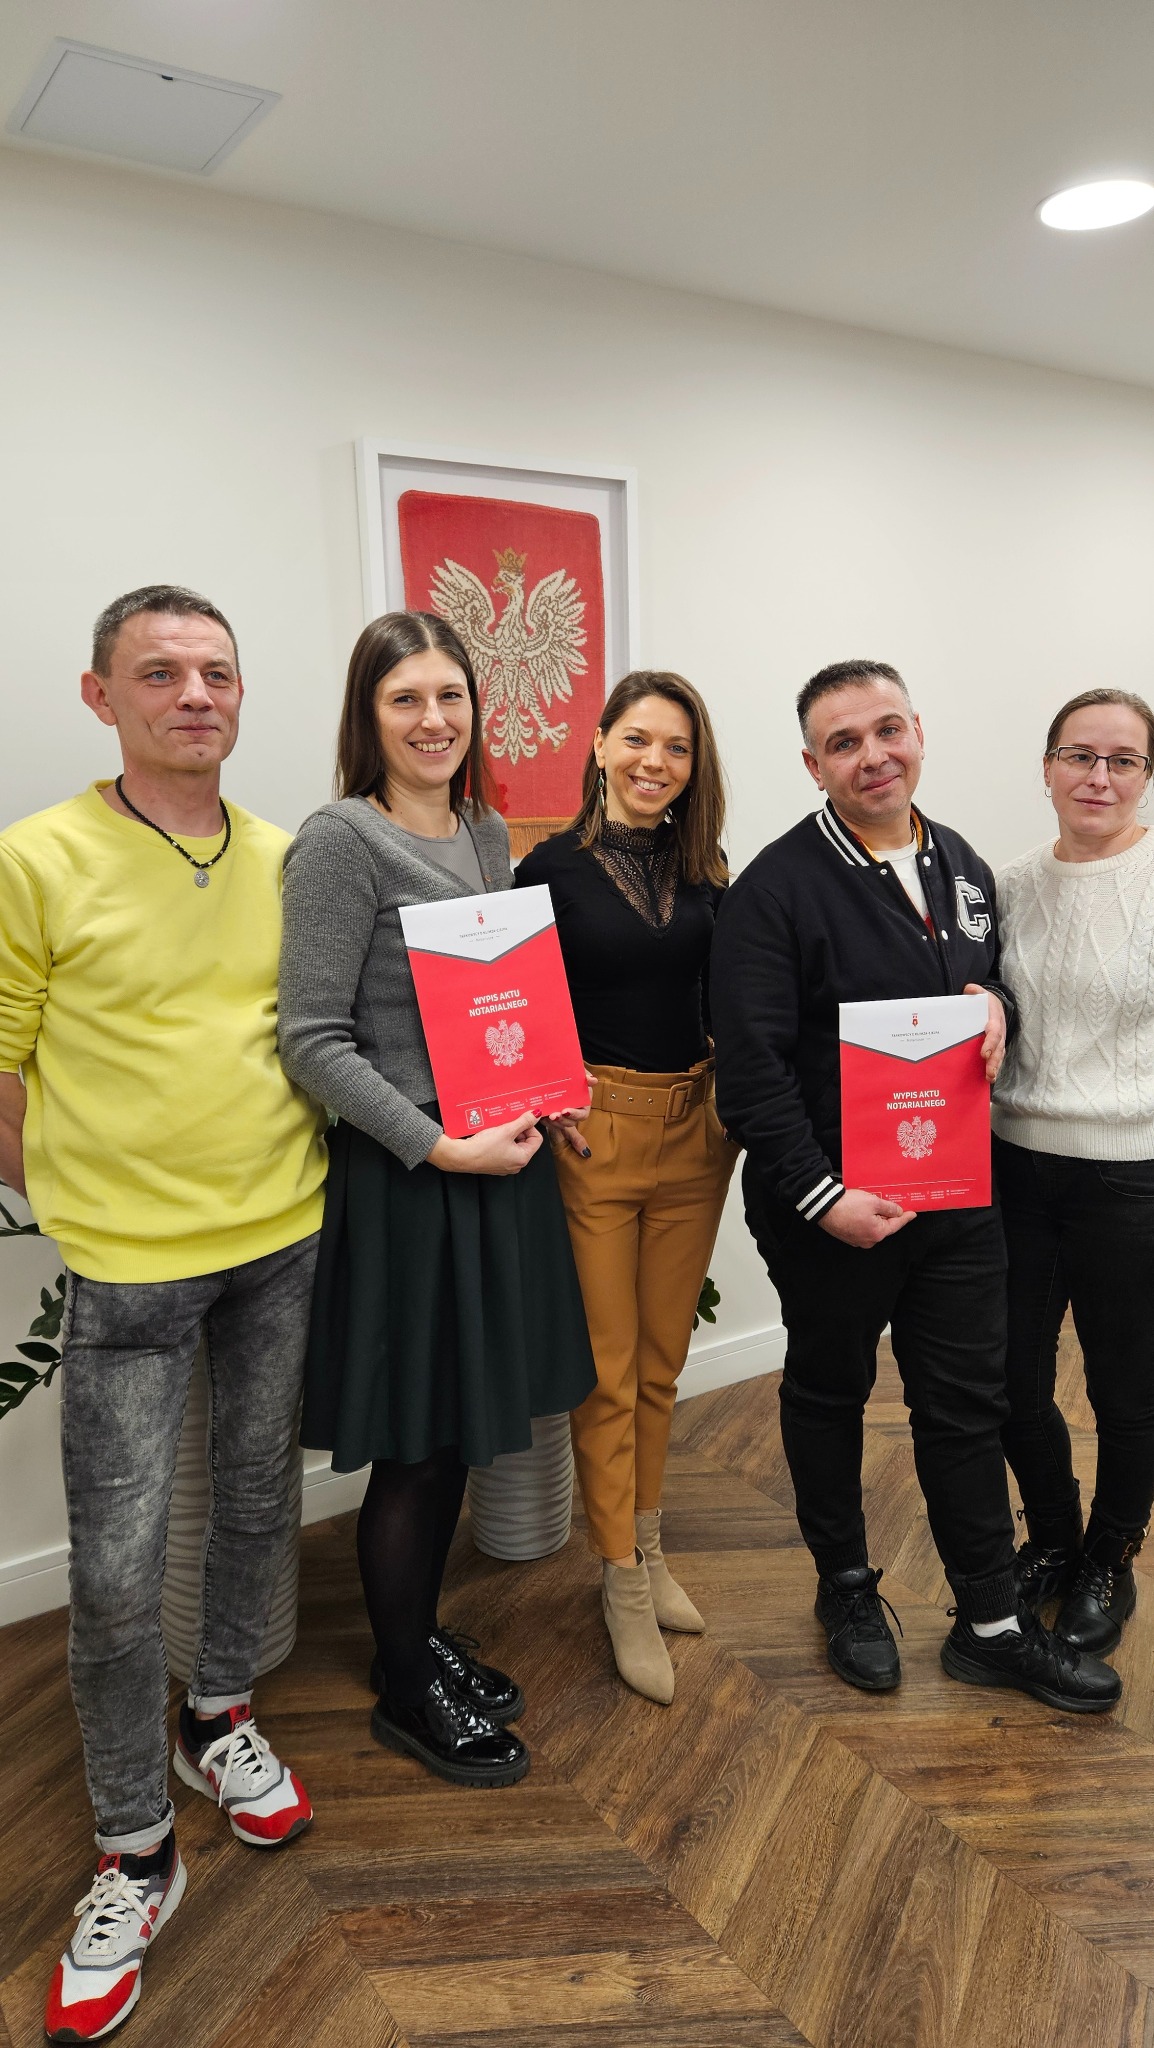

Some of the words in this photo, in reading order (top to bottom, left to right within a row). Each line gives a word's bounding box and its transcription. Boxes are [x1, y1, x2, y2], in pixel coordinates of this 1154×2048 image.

[954, 876, 992, 943] C
[473, 993, 498, 1005] WYPIS
[500, 989, 520, 1000] AKTU
[469, 998, 528, 1017] NOTARIALNEGO
[893, 1091, 918, 1100] WYPIS
[919, 1089, 940, 1098] AKTU
[886, 1099, 946, 1110] NOTARIALNEGO
